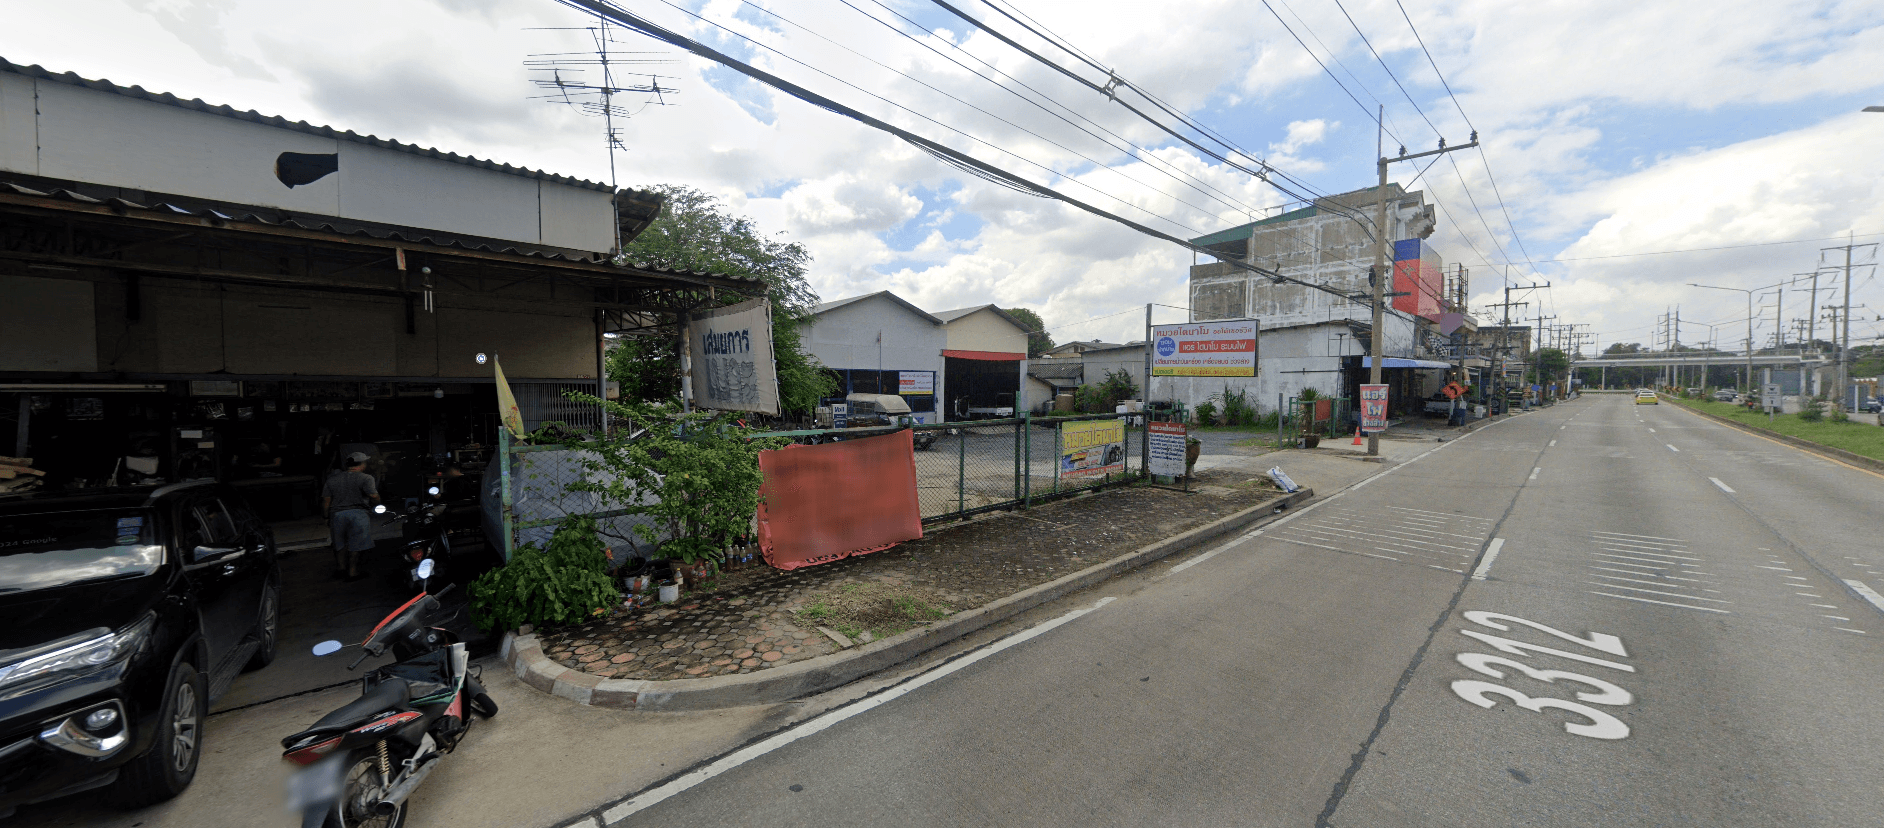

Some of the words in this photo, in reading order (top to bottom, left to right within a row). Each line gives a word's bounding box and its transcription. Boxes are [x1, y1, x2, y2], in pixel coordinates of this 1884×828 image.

[1156, 326, 1209, 337] หมวยไดนาโม
[1182, 342, 1195, 351] แอร์
[1197, 341, 1219, 351] ไดนาโม
[1220, 340, 1247, 350] ระบบไฟ
[1362, 387, 1388, 400] แอร์
[1366, 402, 1383, 416] ไฟ
[1063, 420, 1124, 449] หมวยไดนาโม
